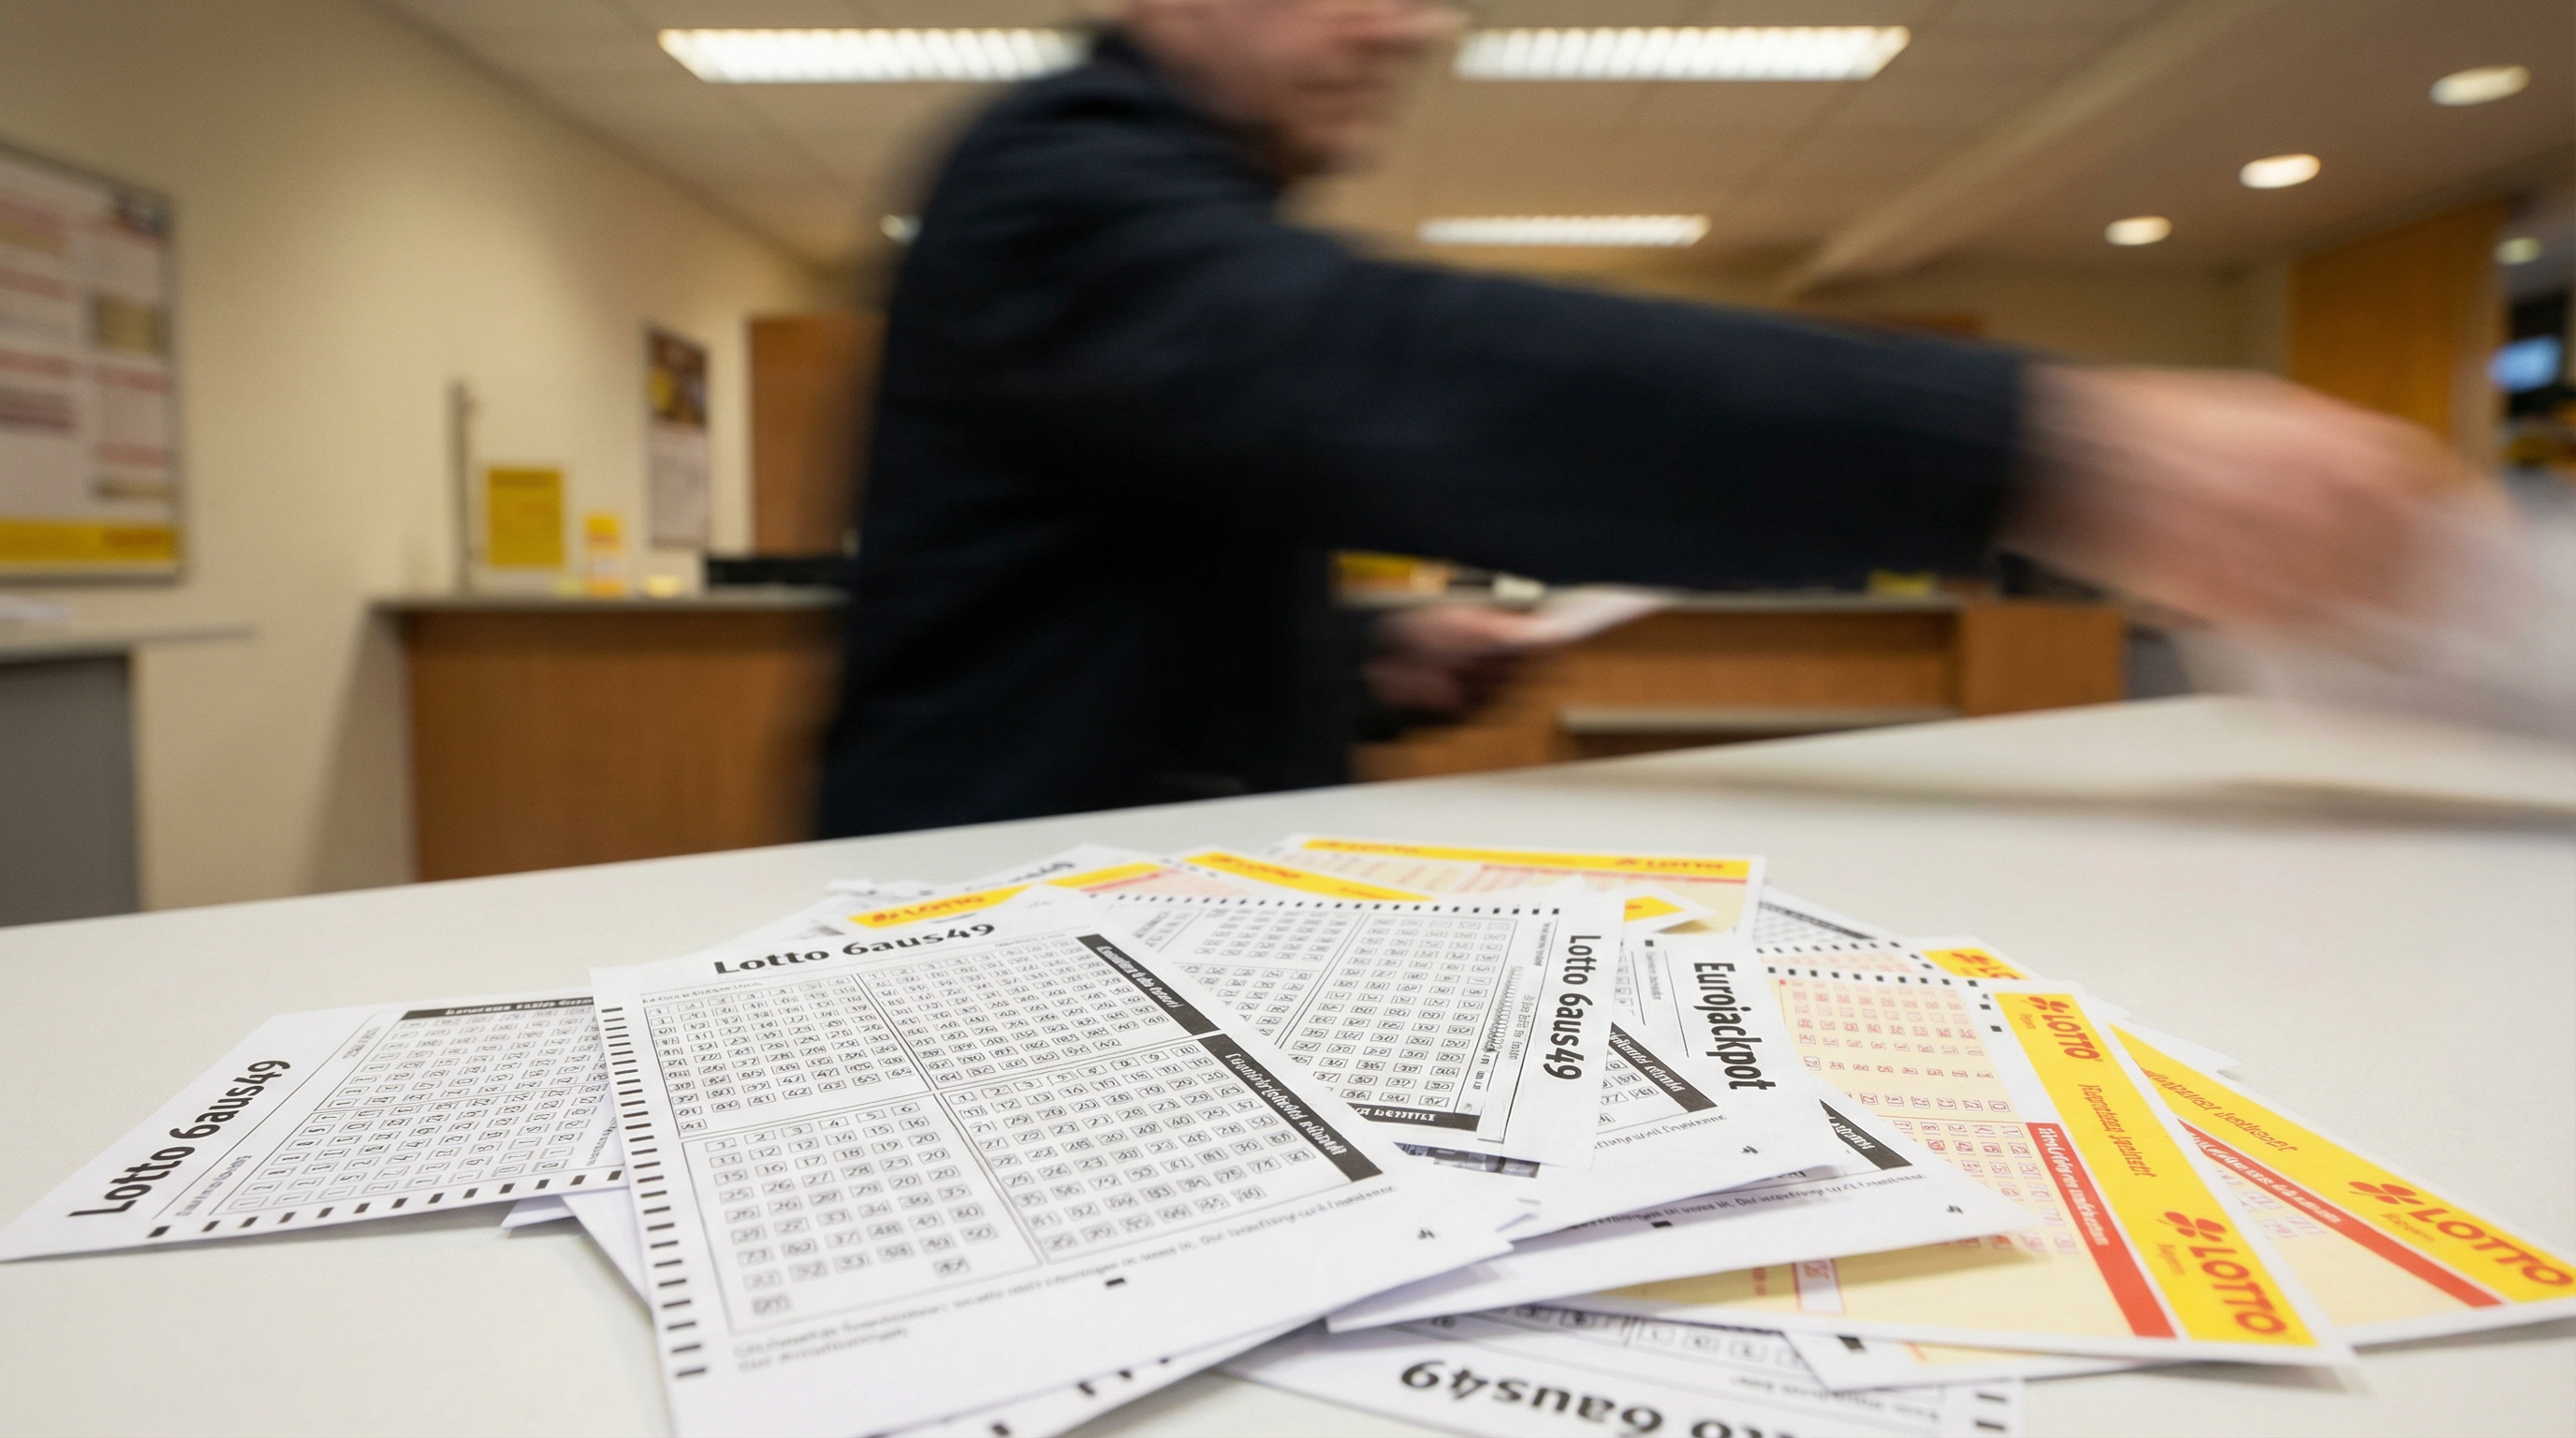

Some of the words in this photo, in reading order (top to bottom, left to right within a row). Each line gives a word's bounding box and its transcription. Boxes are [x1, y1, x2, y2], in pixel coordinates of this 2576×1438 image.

[713, 949, 829, 975] Lotto
[842, 923, 995, 956] 6aus49
[1562, 934, 1602, 985] Lotto
[1543, 991, 1593, 1080] 6aus49
[1692, 961, 1777, 1091] Eurojackpot
[2041, 1013, 2101, 1061] LOTTO
[67, 1145, 196, 1217] Lotto
[169, 1059, 291, 1140] 6aus49
[2406, 1207, 2576, 1286] LOTTO
[2188, 1245, 2289, 1336] LOTTO
[1400, 1359, 1664, 1438] 6aus49
